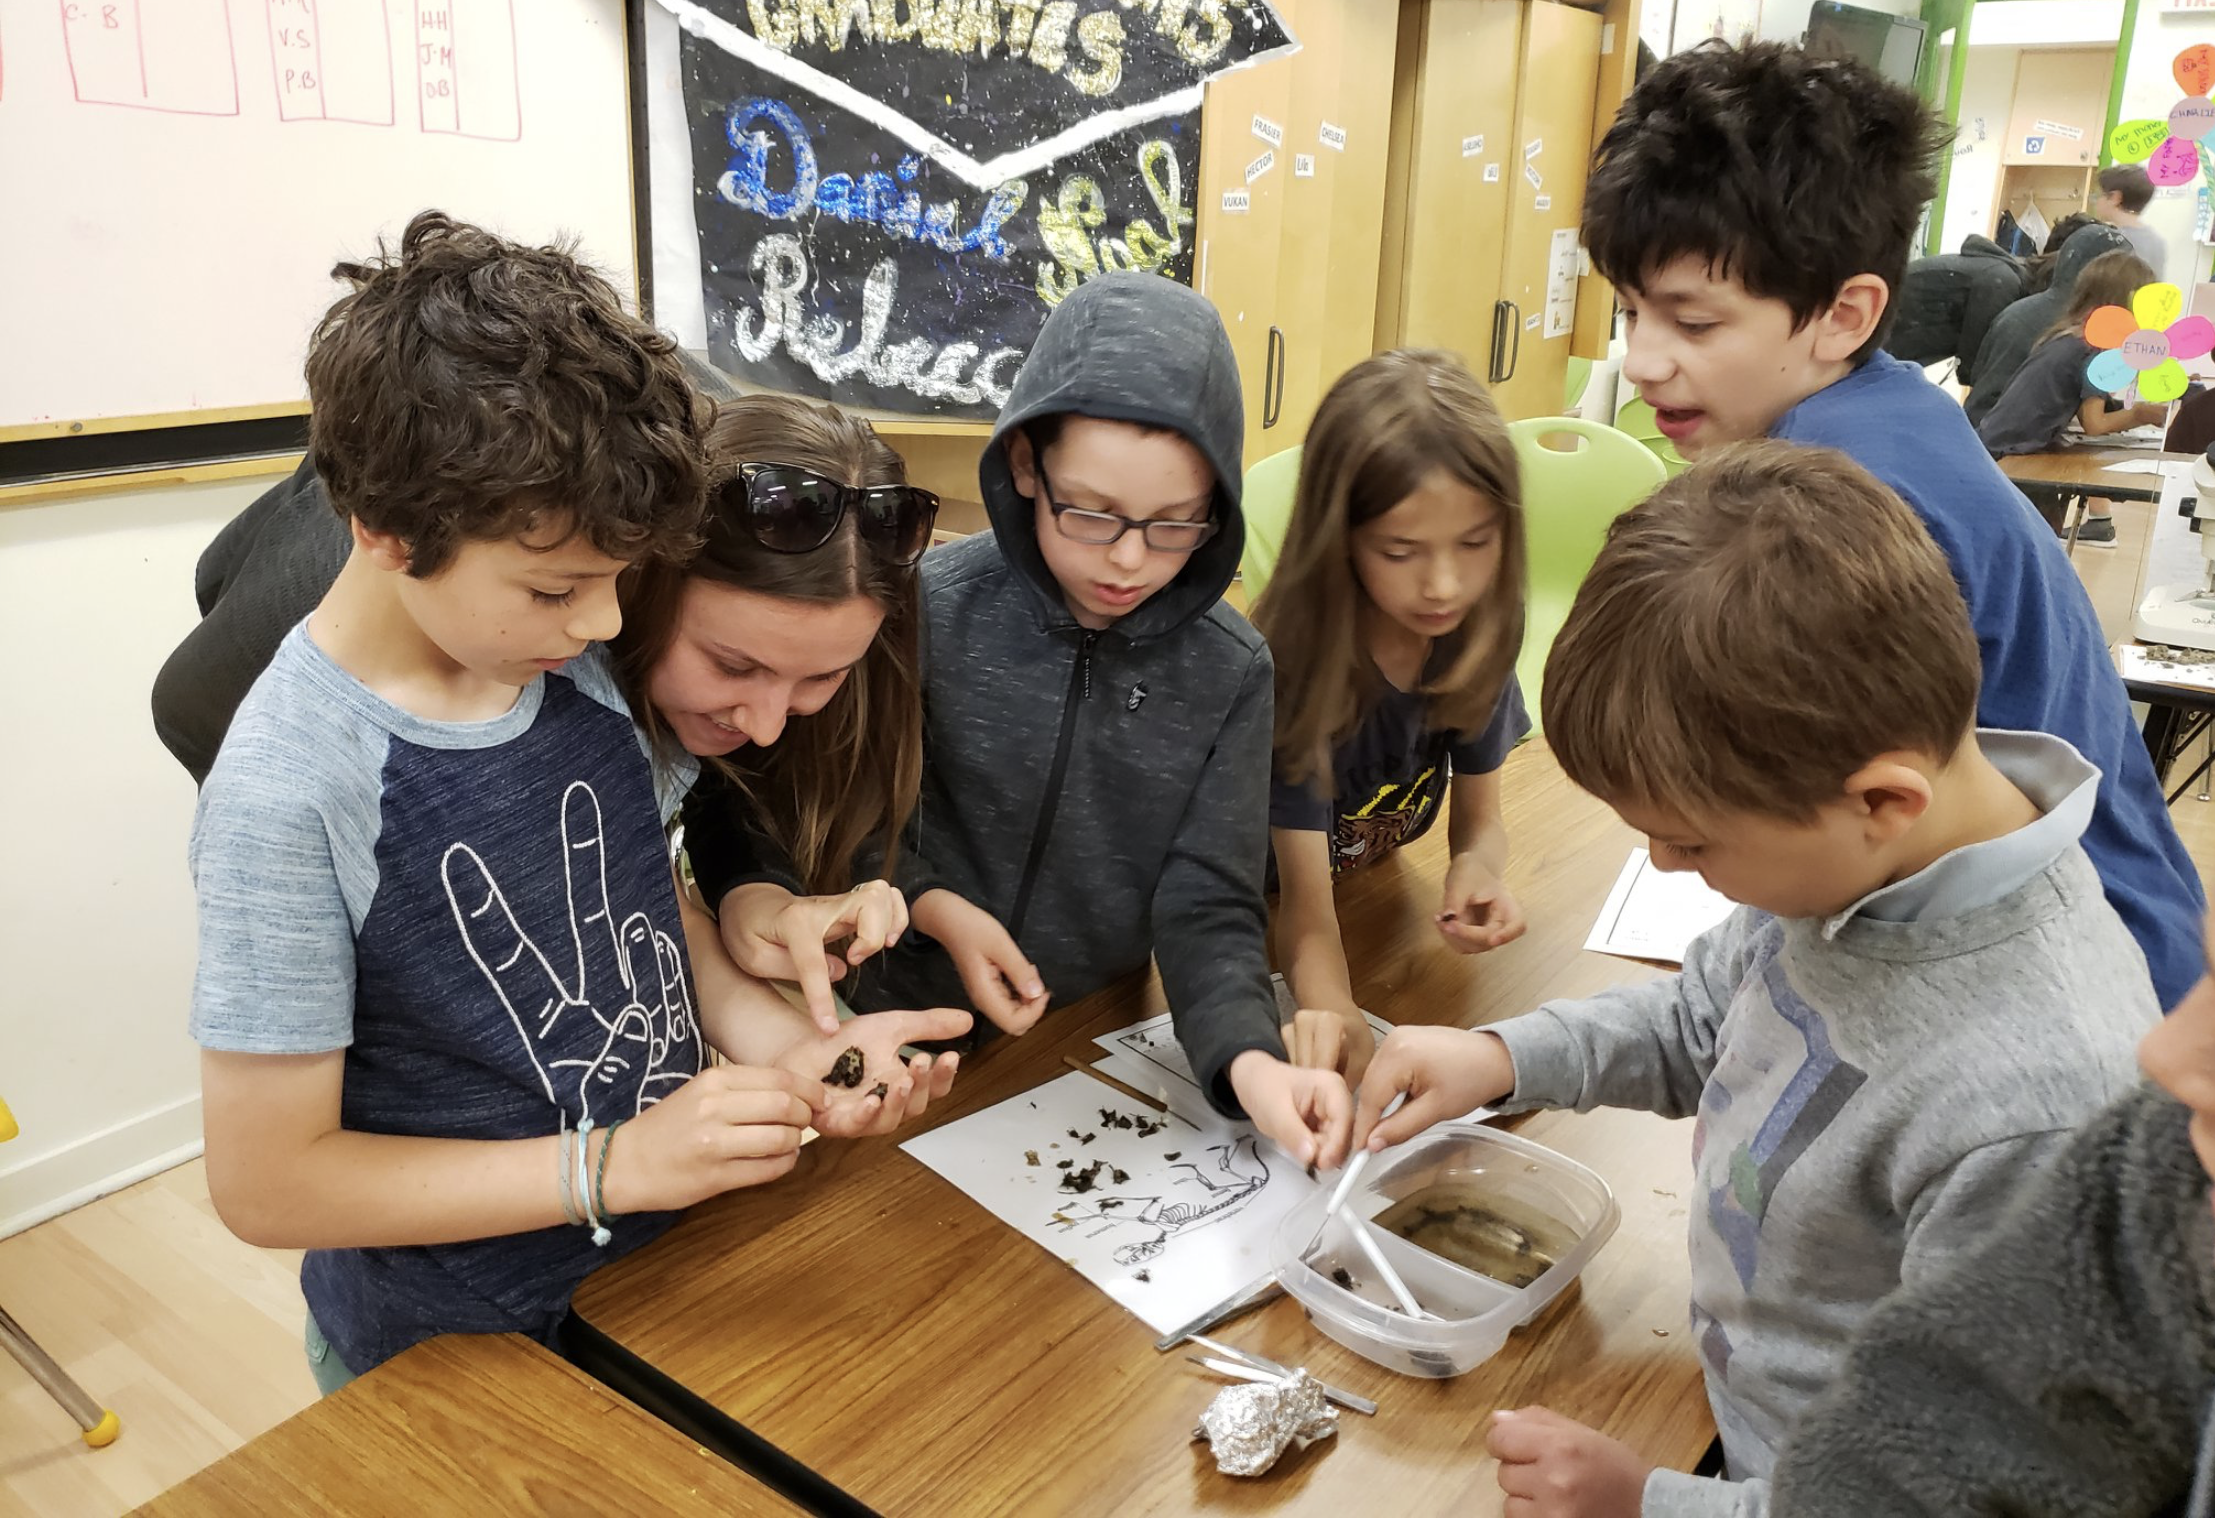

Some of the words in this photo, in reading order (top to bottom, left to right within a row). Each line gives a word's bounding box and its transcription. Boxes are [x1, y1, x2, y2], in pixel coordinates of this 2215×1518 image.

[279, 27, 311, 49] V.S
[285, 69, 317, 94] P.B
[1253, 118, 1281, 141] FRASIER
[1246, 152, 1273, 179] HECTOR
[717, 96, 1029, 266] Daniel
[1223, 196, 1249, 208] VUKAN
[2123, 342, 2167, 356] ETHAN
